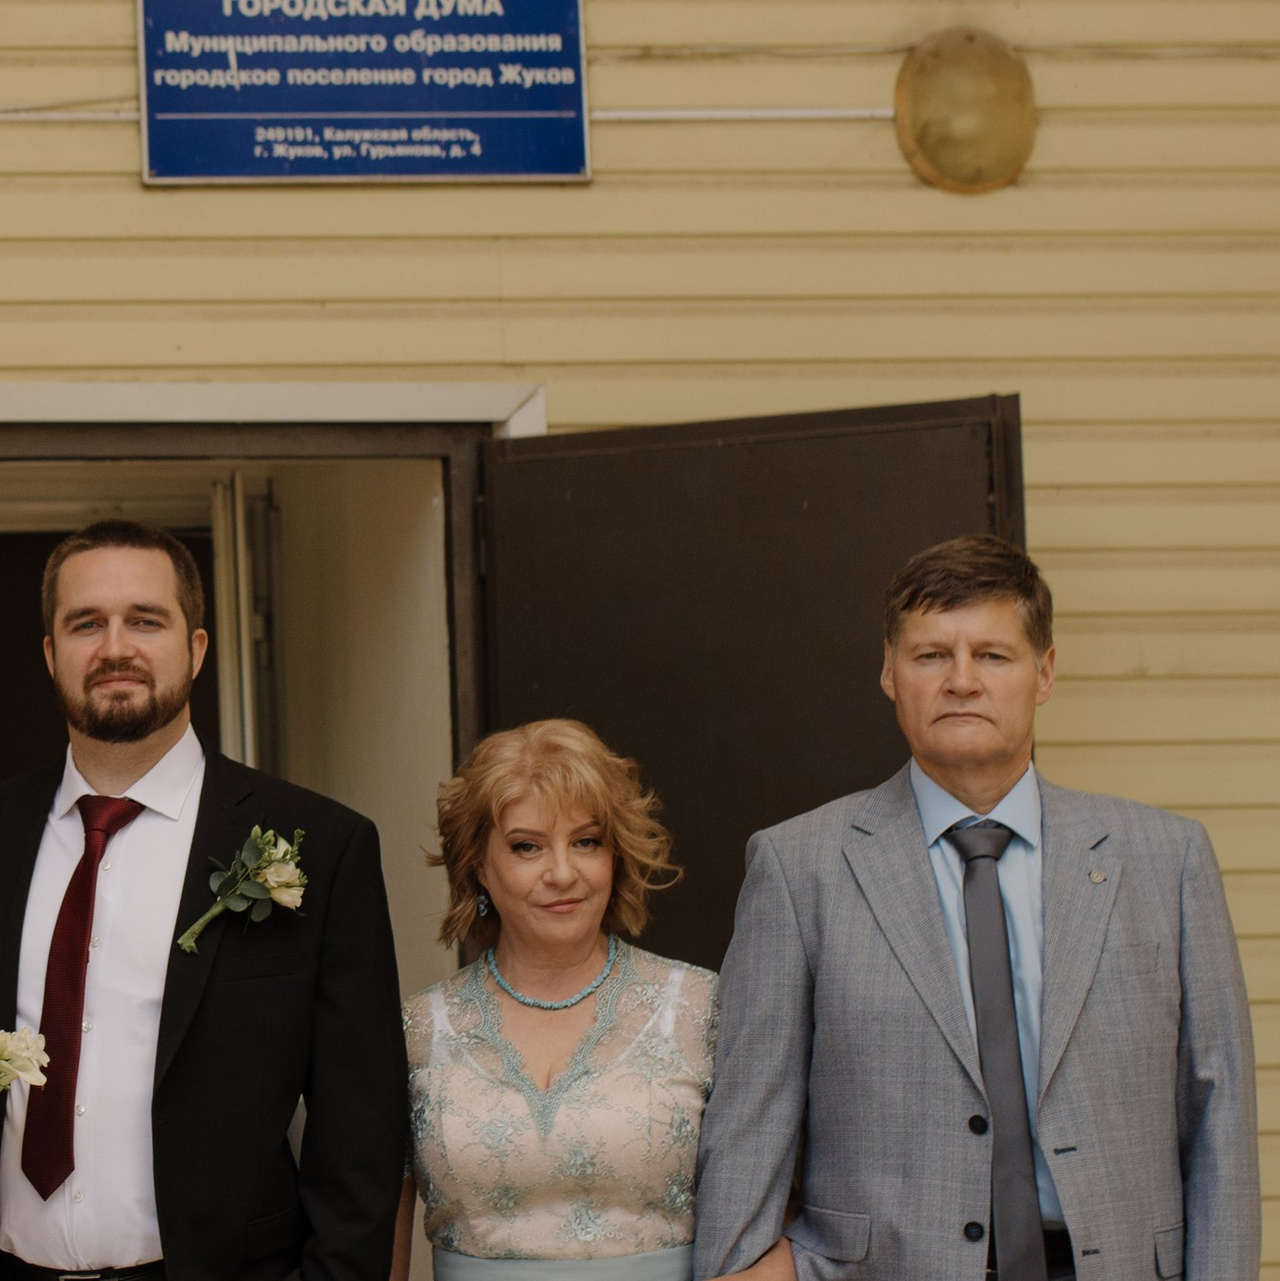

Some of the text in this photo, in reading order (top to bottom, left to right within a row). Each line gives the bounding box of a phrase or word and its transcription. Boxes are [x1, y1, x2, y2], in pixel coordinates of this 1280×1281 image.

[164, 28, 562, 57] Муниципального образования
[153, 63, 575, 89] городское поселение город Жуков
[323, 126, 409, 144] Калужская
[470, 141, 482, 156] 4
